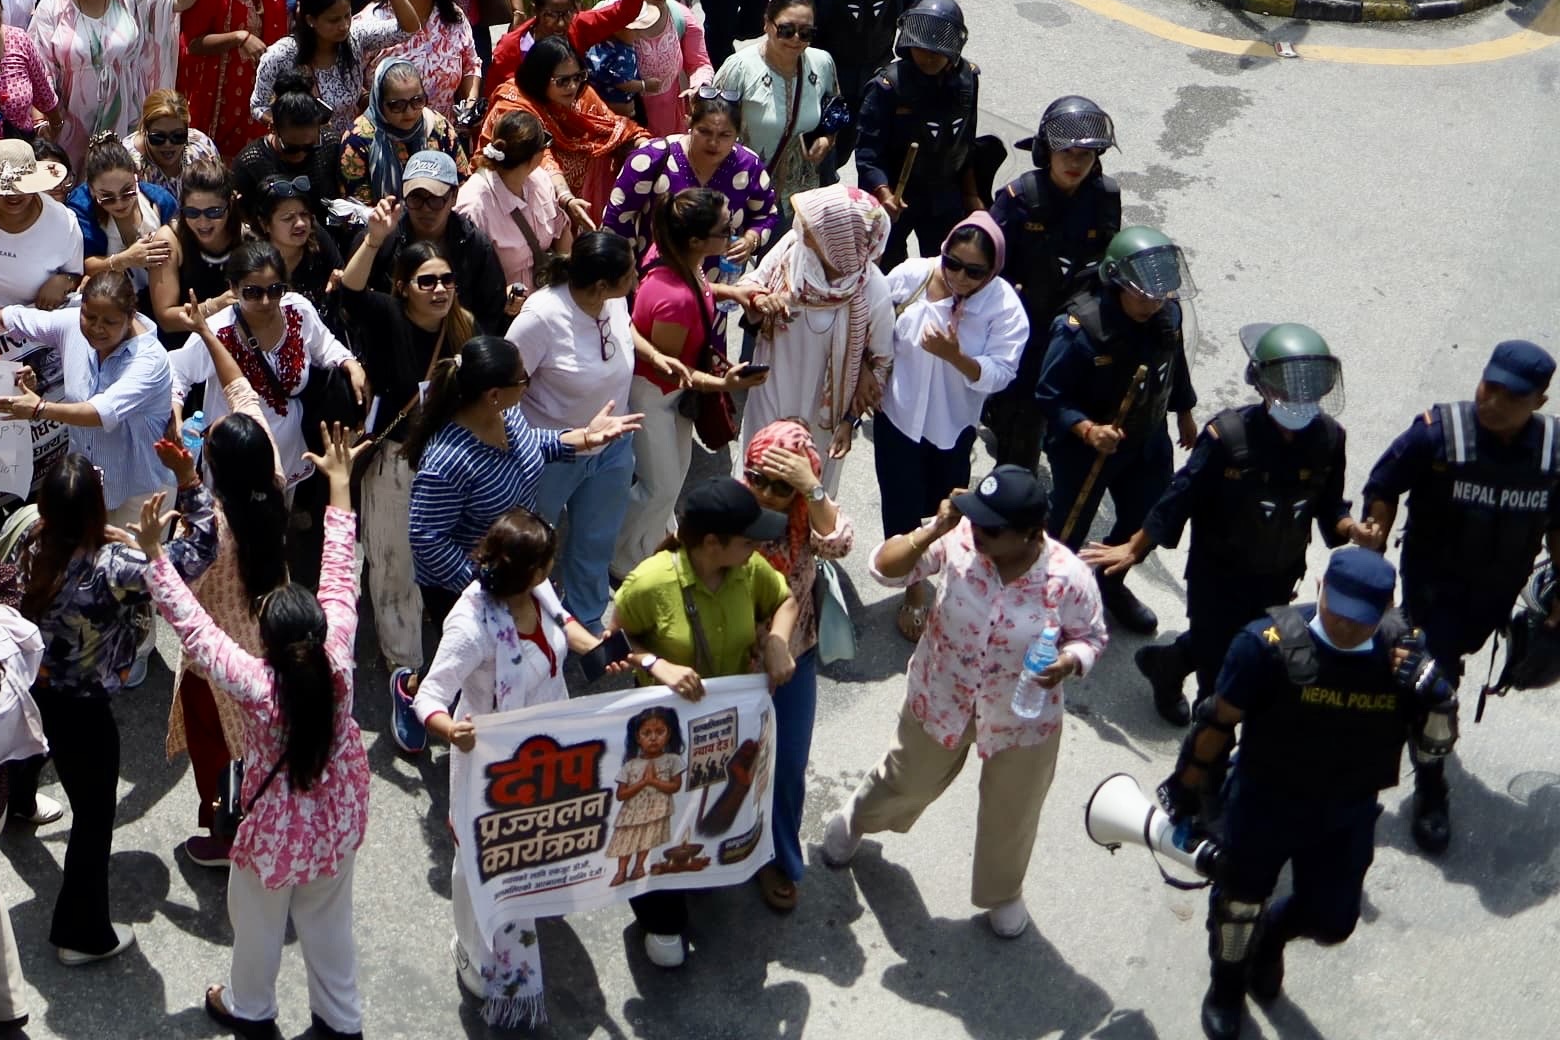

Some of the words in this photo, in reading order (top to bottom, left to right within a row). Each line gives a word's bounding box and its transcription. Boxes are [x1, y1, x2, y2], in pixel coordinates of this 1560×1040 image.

[0, 250, 17, 258] ZARA
[1452, 480, 1496, 505] NEPAL
[1499, 488, 1549, 510] POLICE
[1301, 685, 1345, 707] NEPAL
[1347, 690, 1397, 710] POLICE
[490, 737, 603, 806] दीप
[481, 824, 602, 875] कार्यक्रम
